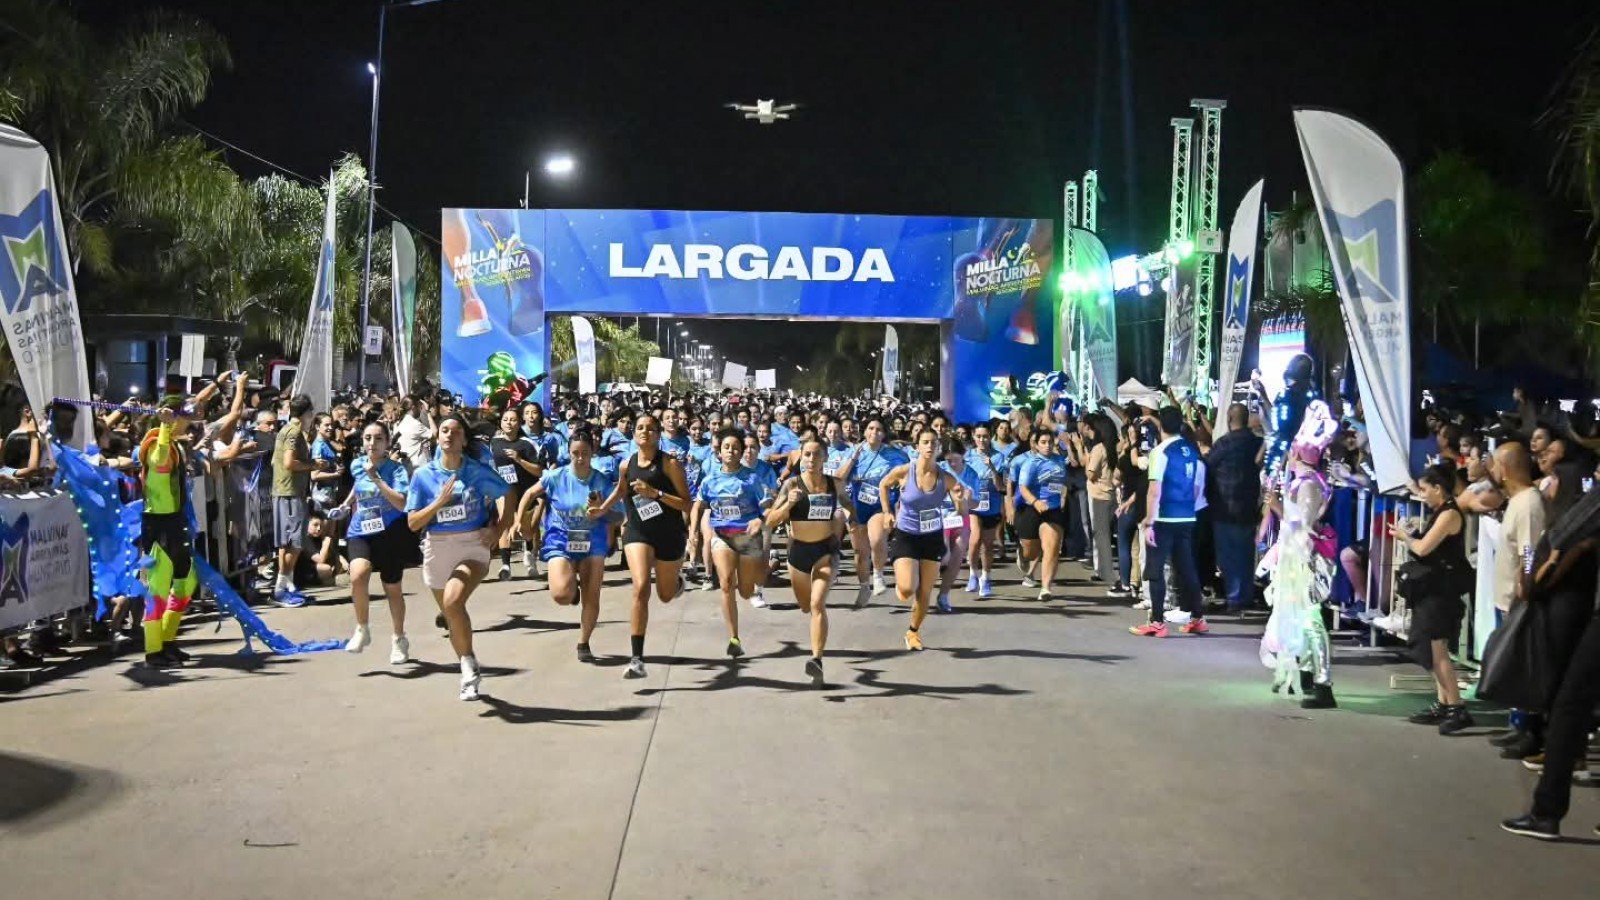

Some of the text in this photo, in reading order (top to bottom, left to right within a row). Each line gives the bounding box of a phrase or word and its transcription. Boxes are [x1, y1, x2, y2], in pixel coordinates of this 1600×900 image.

[454, 248, 497, 267] MILLA
[609, 243, 895, 282] LARGADA
[966, 256, 1009, 276] MILLA
[966, 262, 1041, 290] NOCTURNA
[439, 506, 464, 520] 1504
[640, 503, 661, 518] 1039
